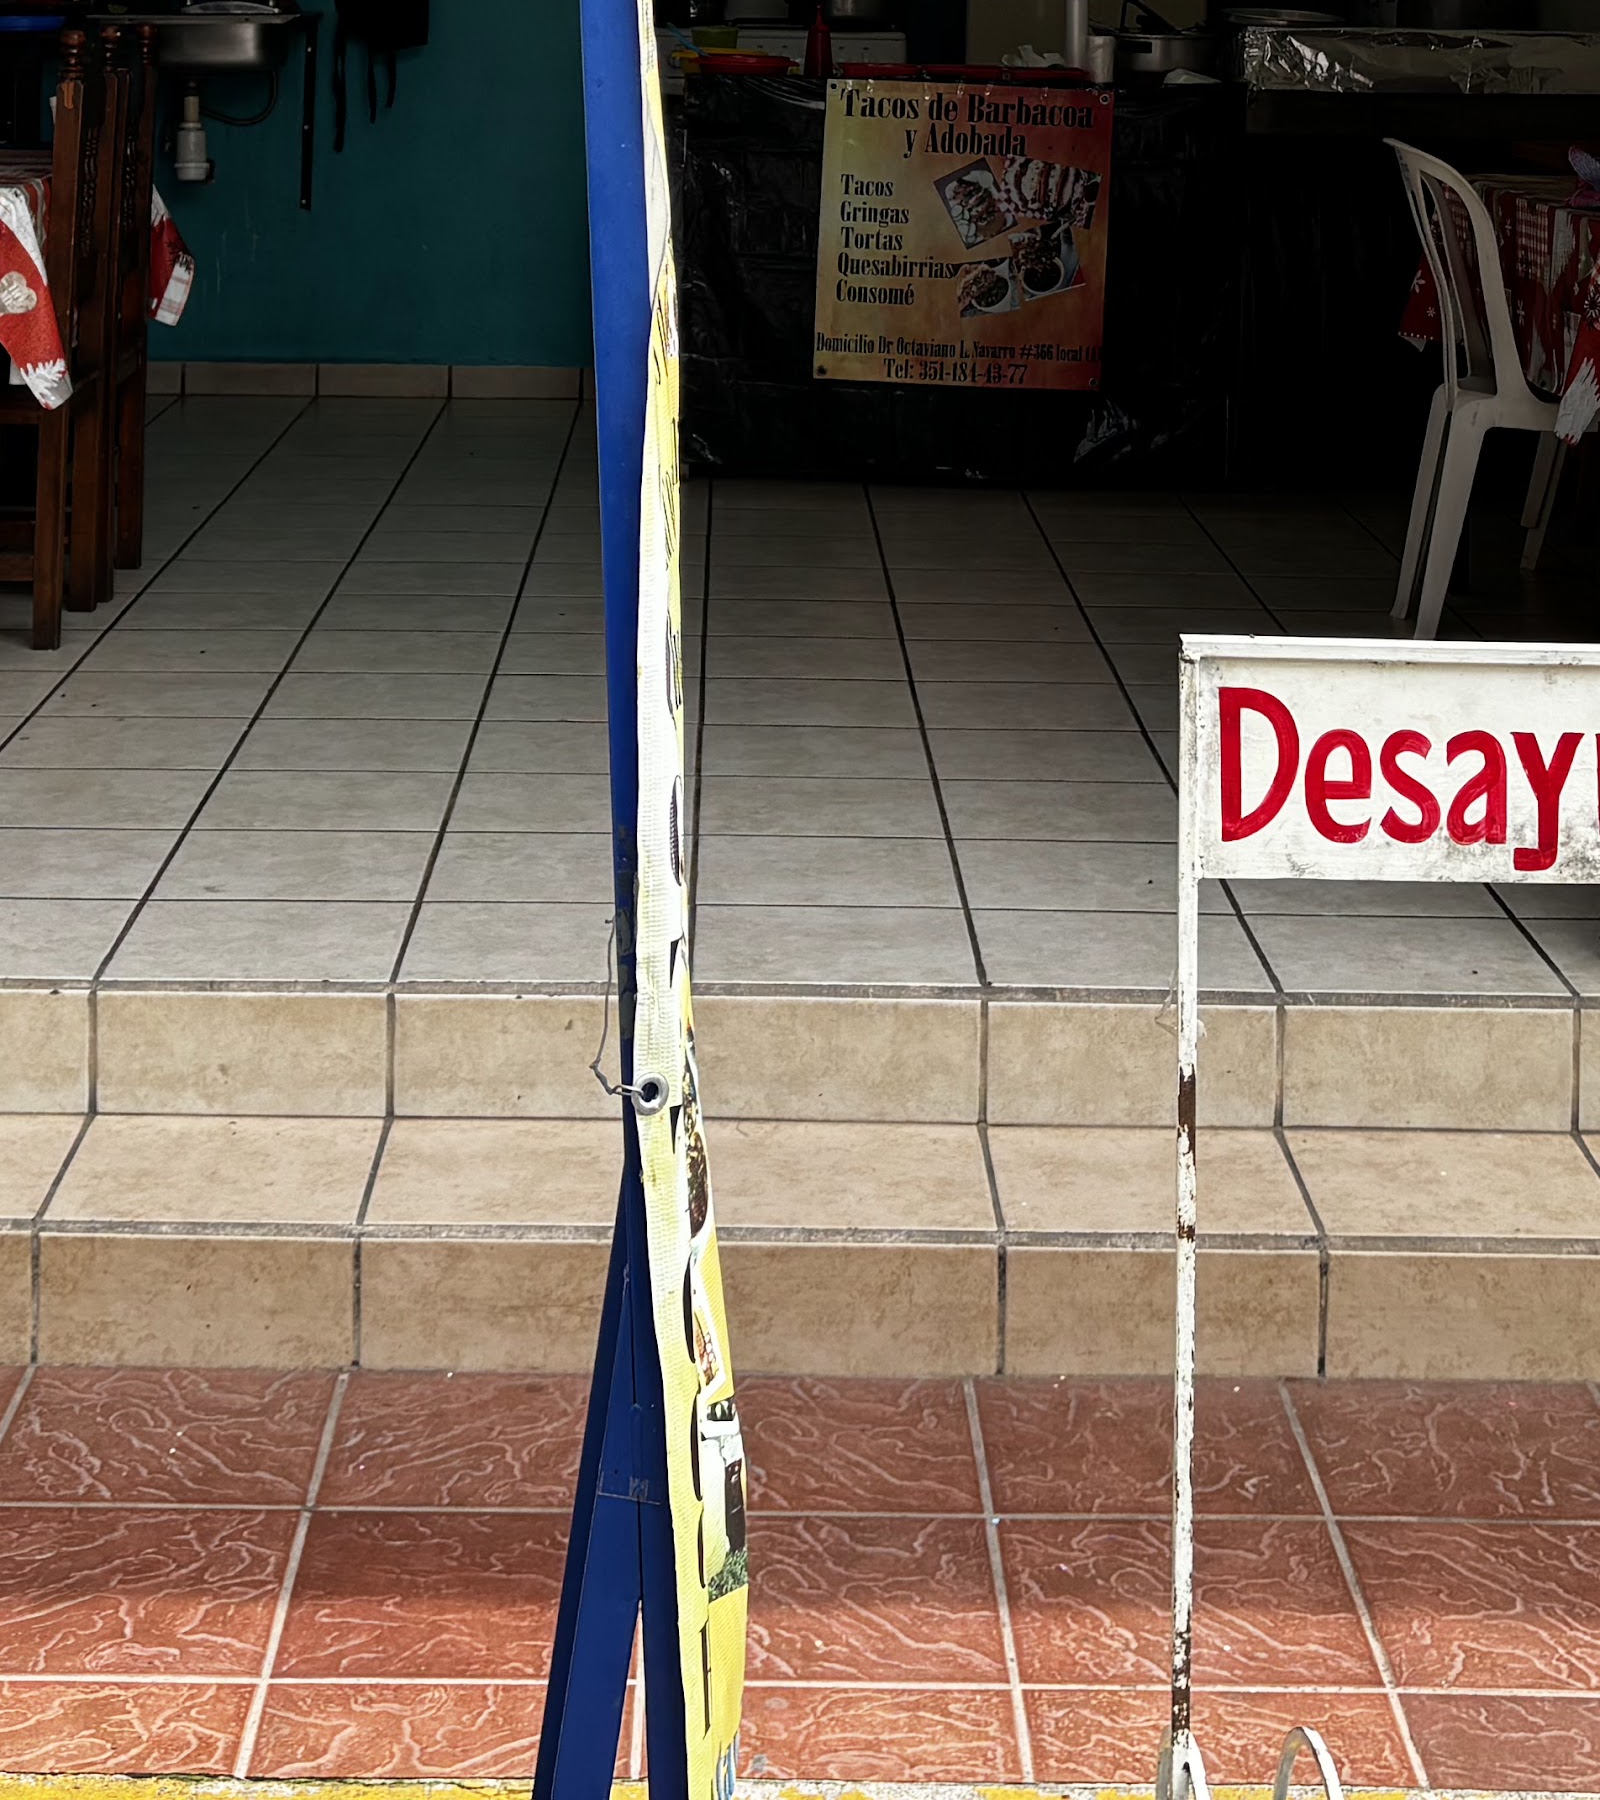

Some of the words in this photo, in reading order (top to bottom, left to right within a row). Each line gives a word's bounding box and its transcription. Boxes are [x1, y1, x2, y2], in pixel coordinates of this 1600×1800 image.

[840, 88, 919, 120] Tacos
[928, 92, 958, 122] de
[967, 93, 1094, 129] Barbacoa
[903, 128, 917, 159] y
[924, 123, 1027, 157] Adobada
[841, 174, 893, 197] Tacos
[840, 201, 909, 228] Gringas
[841, 227, 903, 251] Tortas
[837, 252, 954, 279] Quesabirrias
[836, 278, 915, 306] Consomé
[816, 332, 875, 355] Domicilio
[896, 337, 956, 359] Octaviano
[972, 340, 1016, 360] Navarro
[1056, 343, 1082, 362] local
[884, 358, 914, 379] Tel:
